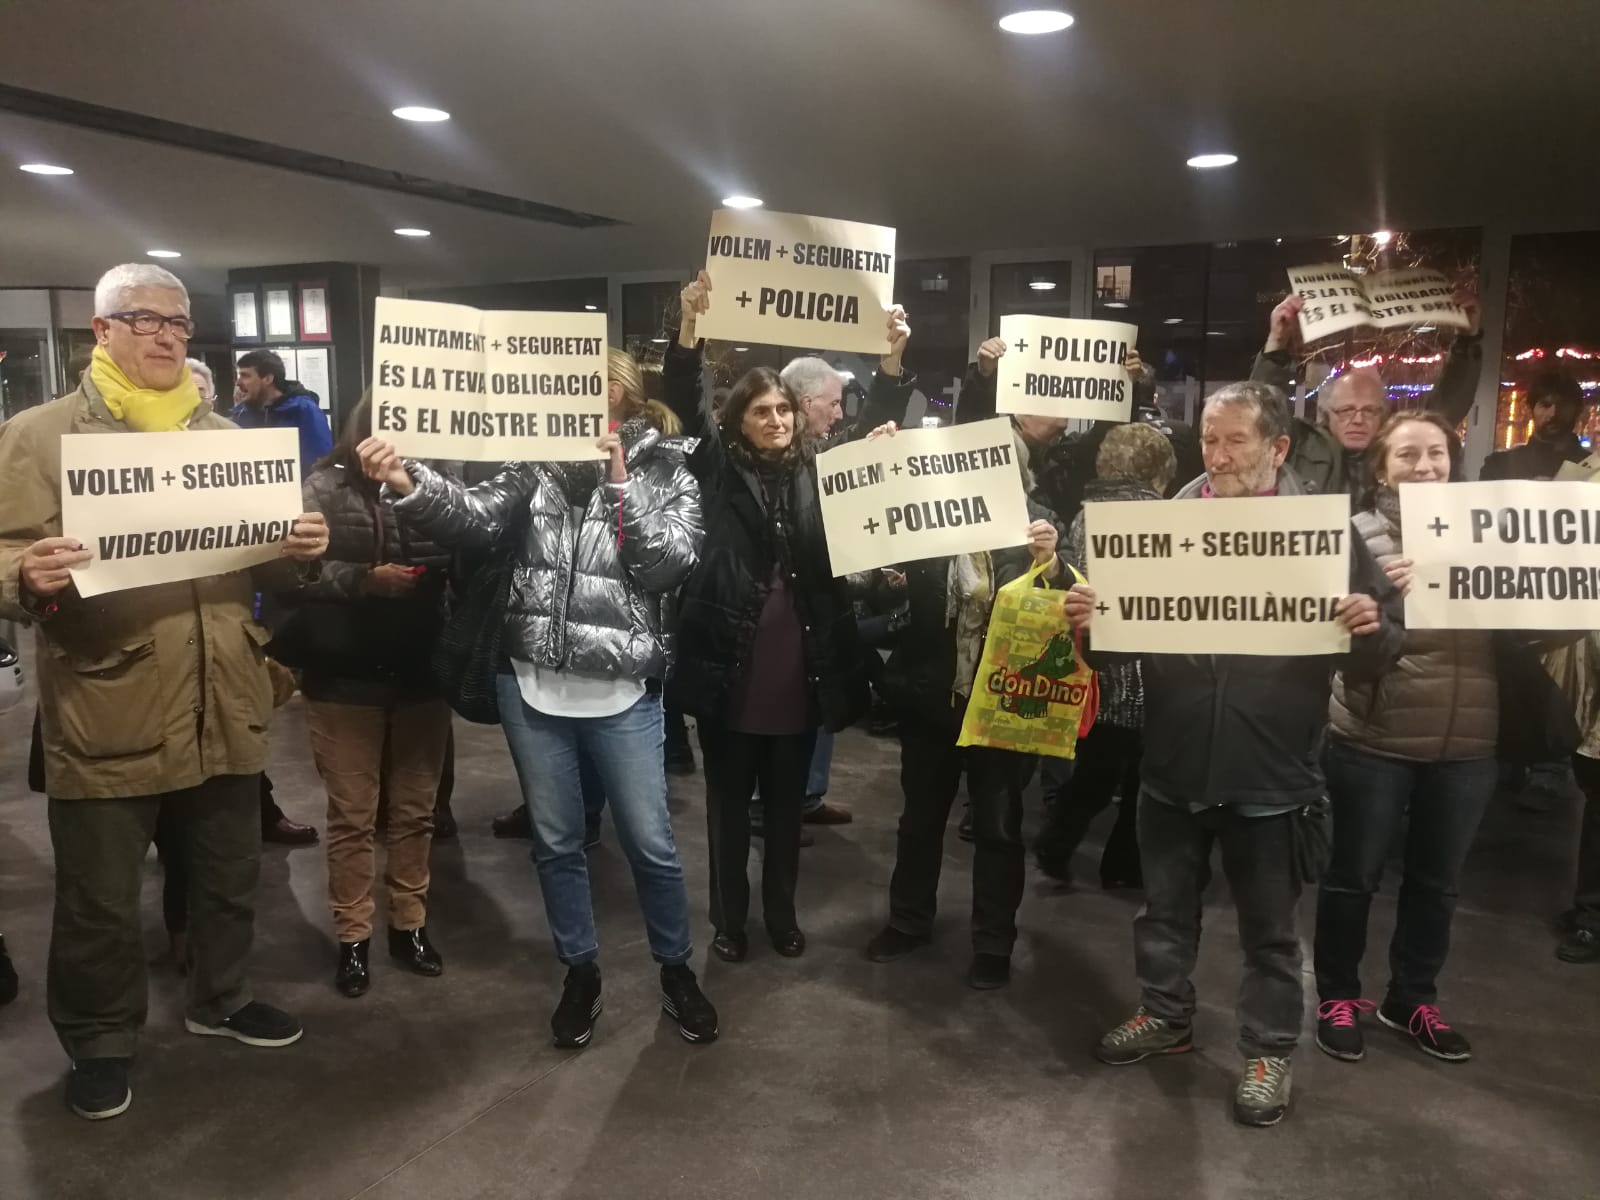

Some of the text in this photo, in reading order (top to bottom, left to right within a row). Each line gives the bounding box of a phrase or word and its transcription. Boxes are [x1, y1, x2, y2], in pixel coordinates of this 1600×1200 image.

[710, 235, 891, 274] VOLEM + SEGURETAT
[1294, 271, 1356, 285] AJUNTAM
[1320, 288, 1337, 298] LA
[735, 287, 859, 324] + POLICIA
[1330, 304, 1349, 316] EL
[1354, 303, 1417, 319] STRE
[380, 324, 603, 356] AJUNTAMENT + SEGURETAT
[1015, 335, 1128, 366] + POLICIA
[379, 360, 602, 396] ÉS LA TEVA OBLIGACIÓ
[1025, 373, 1125, 403] ROBATORIS
[379, 400, 604, 437] ÉS EL NOSTRE DRET
[67, 459, 296, 496] VOLEM + SEGURETAT
[821, 444, 1011, 496] VOLEM + SEGURETAT
[863, 496, 991, 535] + POLICIA
[1427, 507, 1600, 544] + POLICI
[1092, 529, 1344, 559] VOLEM + SEGURETAT
[1449, 565, 1600, 600] ROBATORI
[1095, 600, 1110, 616] +
